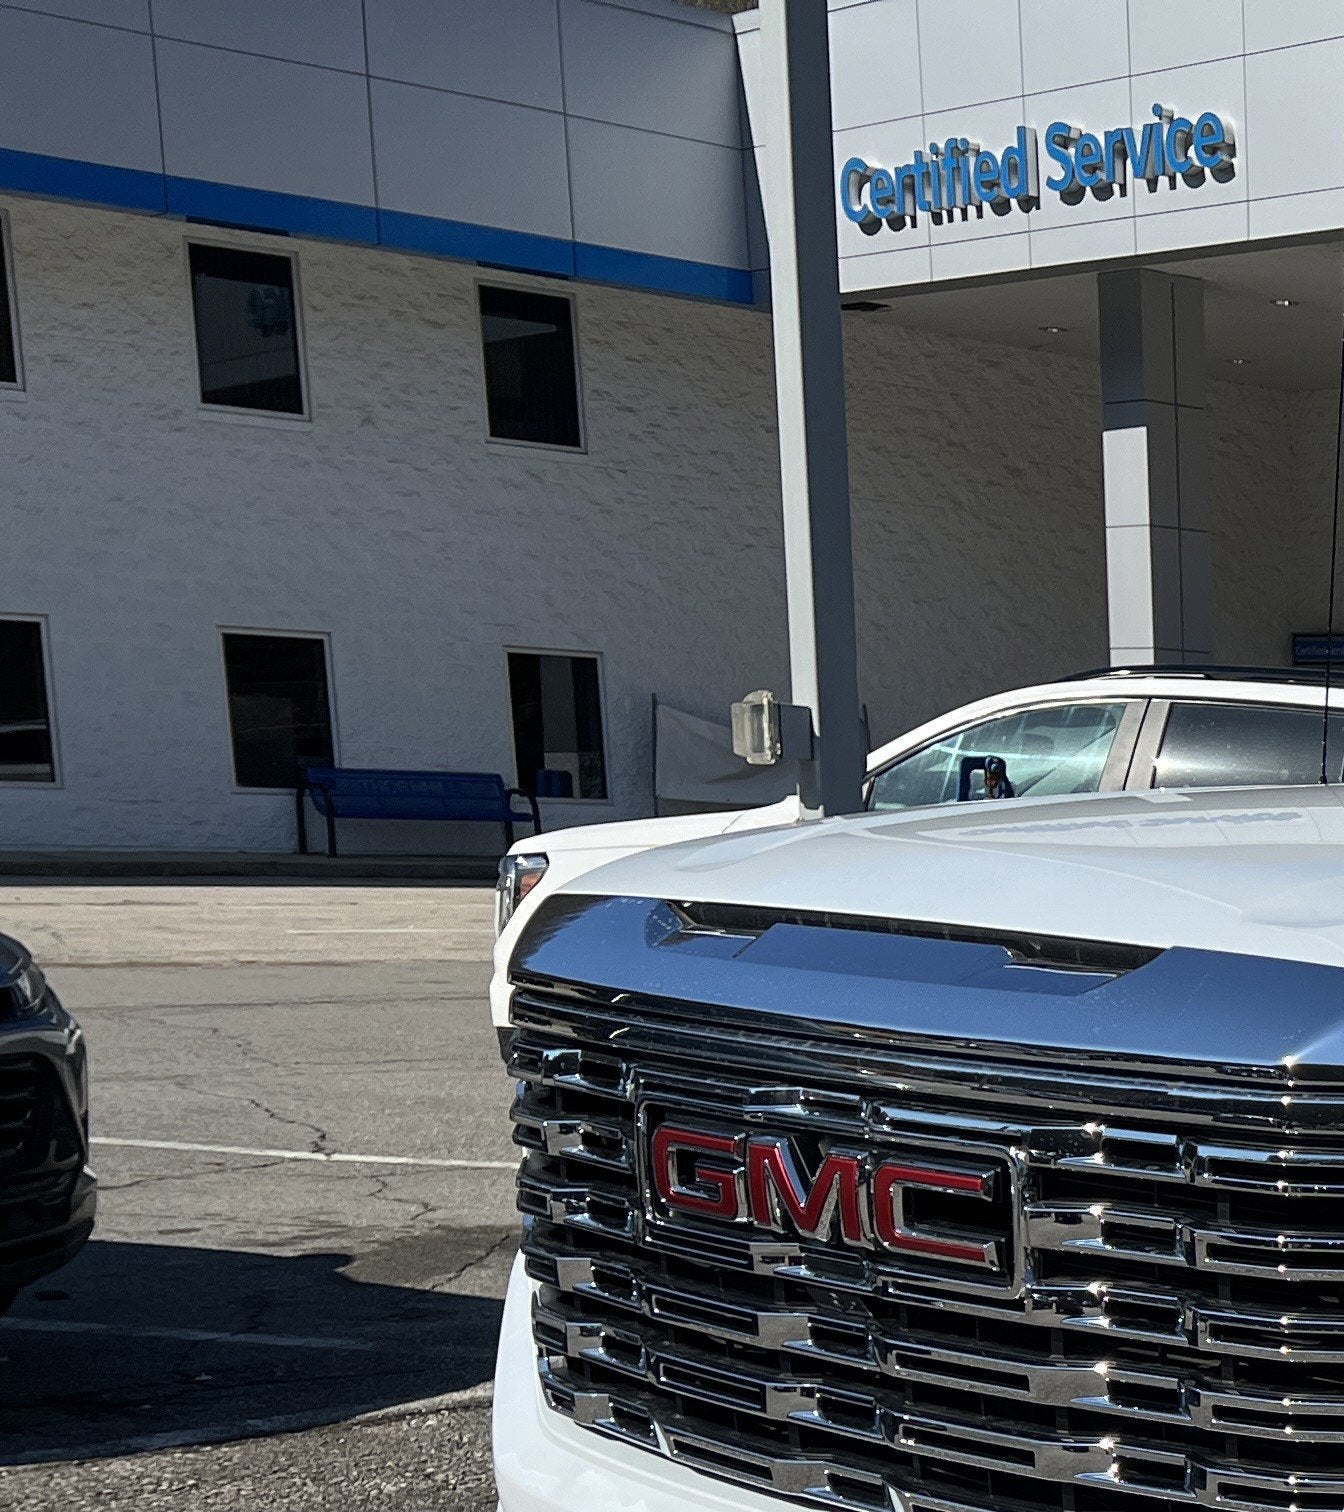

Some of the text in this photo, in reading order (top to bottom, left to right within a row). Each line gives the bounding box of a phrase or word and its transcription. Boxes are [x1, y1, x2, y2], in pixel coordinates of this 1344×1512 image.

[840, 103, 1230, 224] Certified Service
[652, 1121, 997, 1269] GMC
